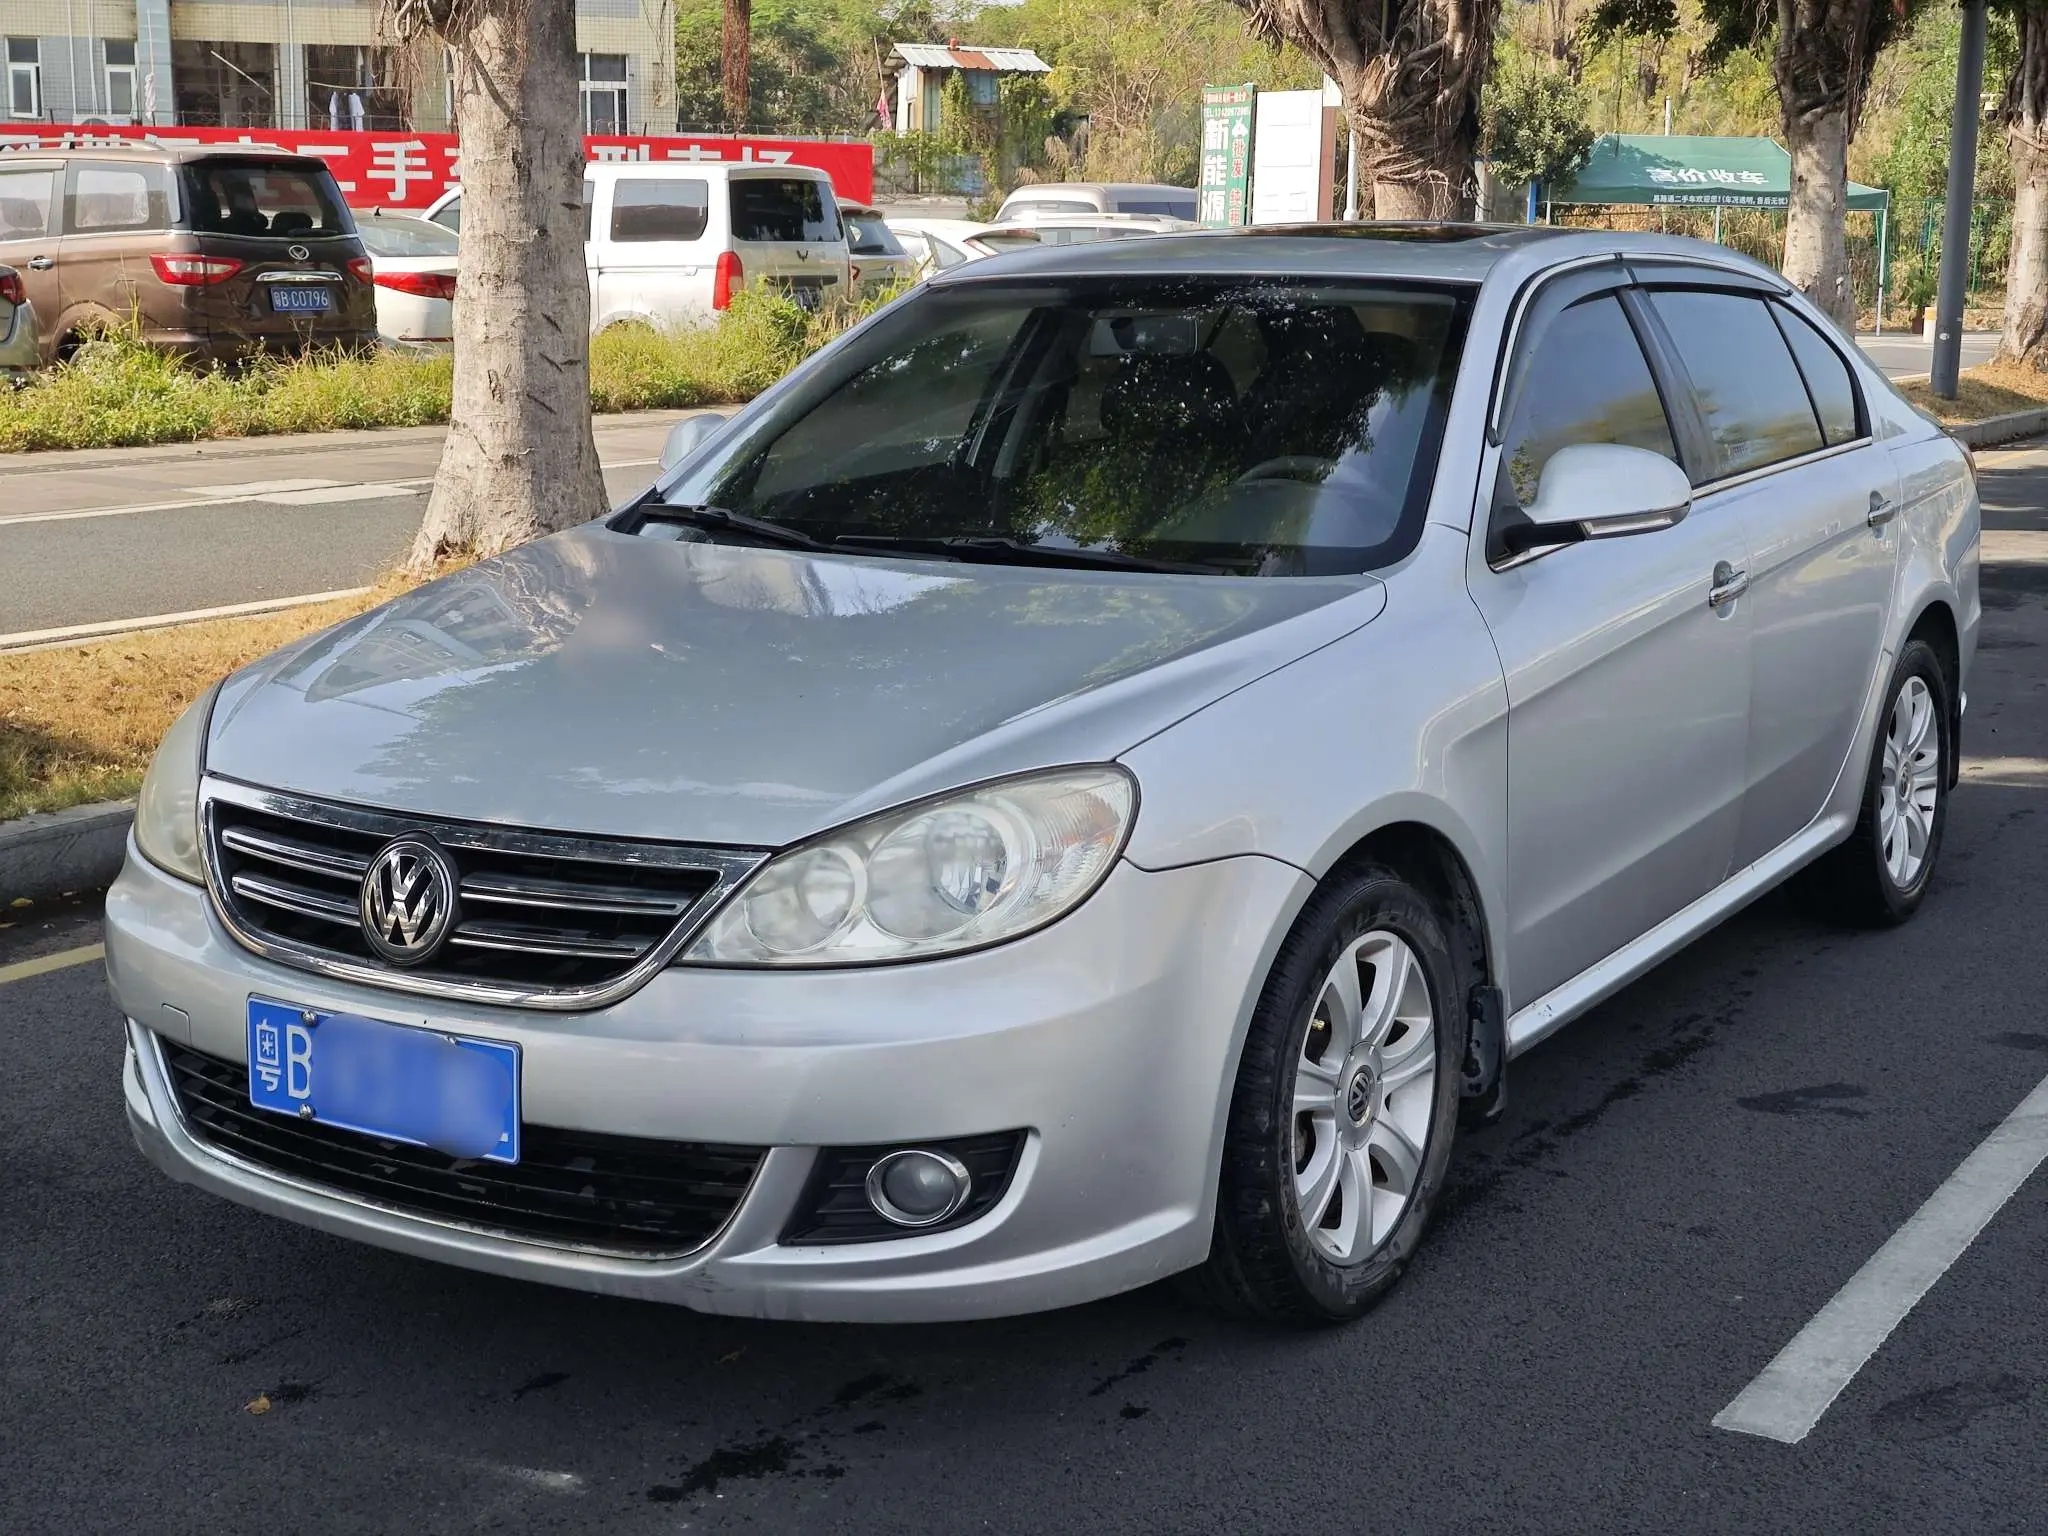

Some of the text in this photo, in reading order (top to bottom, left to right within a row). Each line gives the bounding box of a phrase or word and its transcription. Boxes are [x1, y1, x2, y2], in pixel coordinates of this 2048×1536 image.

[1202, 119, 1230, 221] 新能源
[1646, 168, 1769, 184] 高价收车
